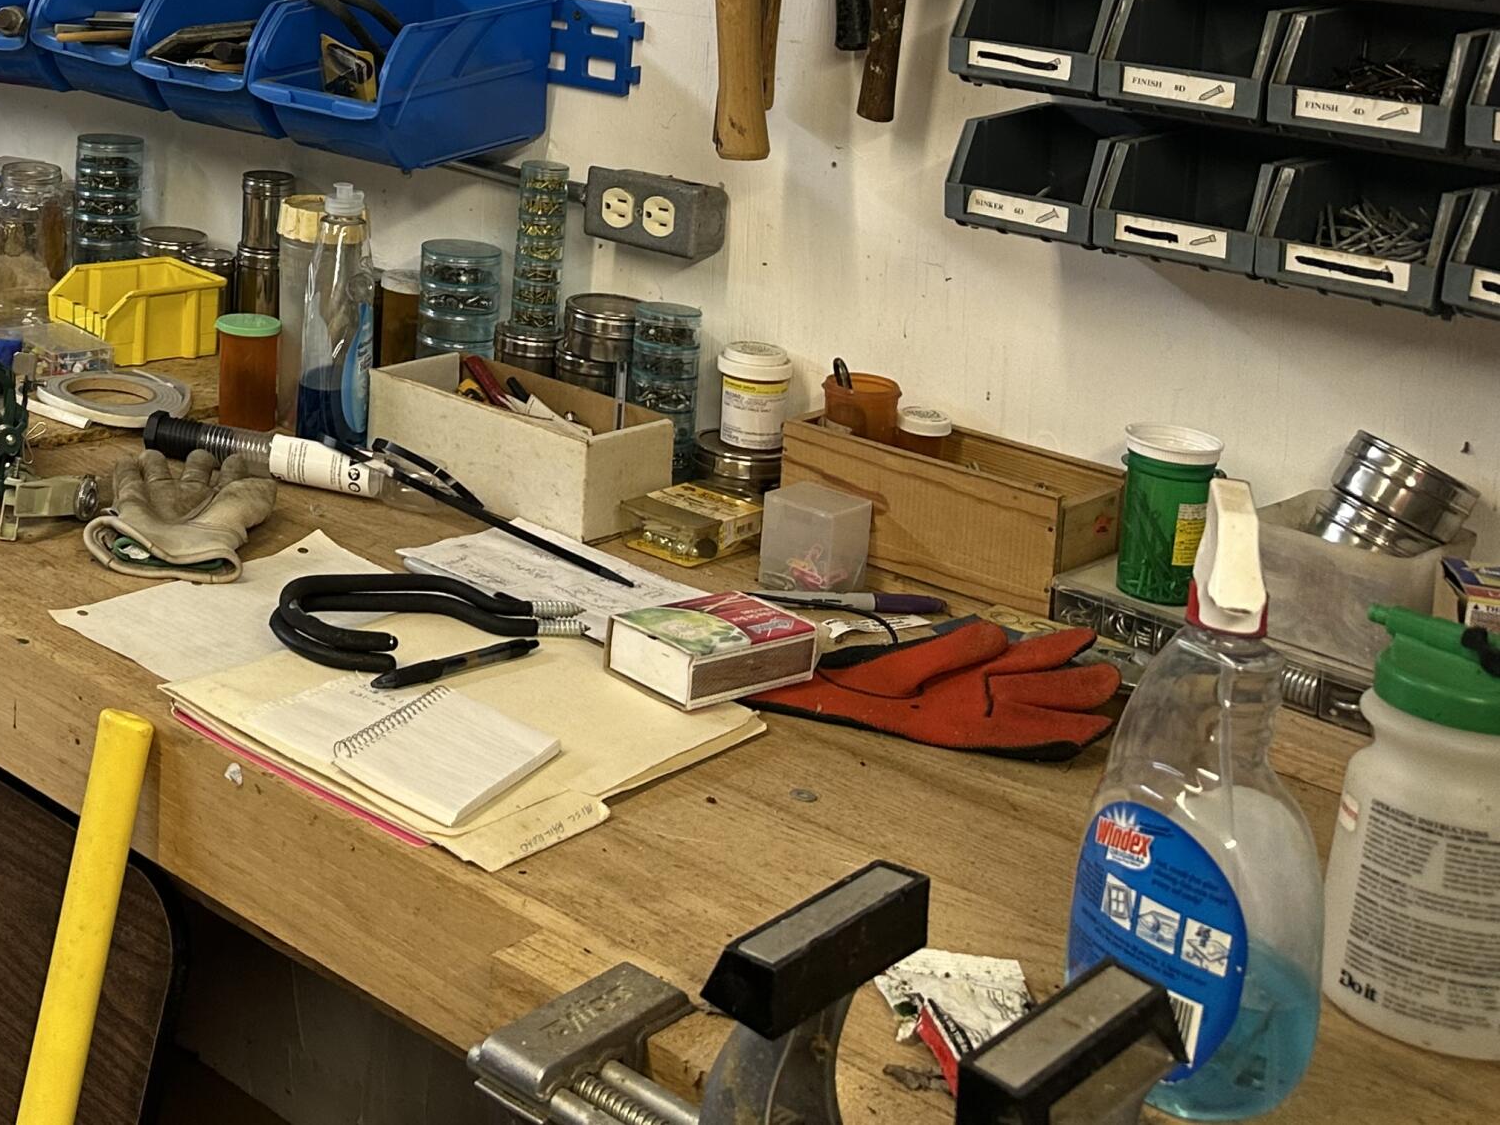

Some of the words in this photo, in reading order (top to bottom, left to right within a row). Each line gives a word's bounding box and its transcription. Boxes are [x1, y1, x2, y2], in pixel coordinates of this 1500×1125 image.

[1131, 77, 1163, 89] FINISH
[1304, 100, 1339, 113] FINISH
[1097, 817, 1152, 857] Windex
